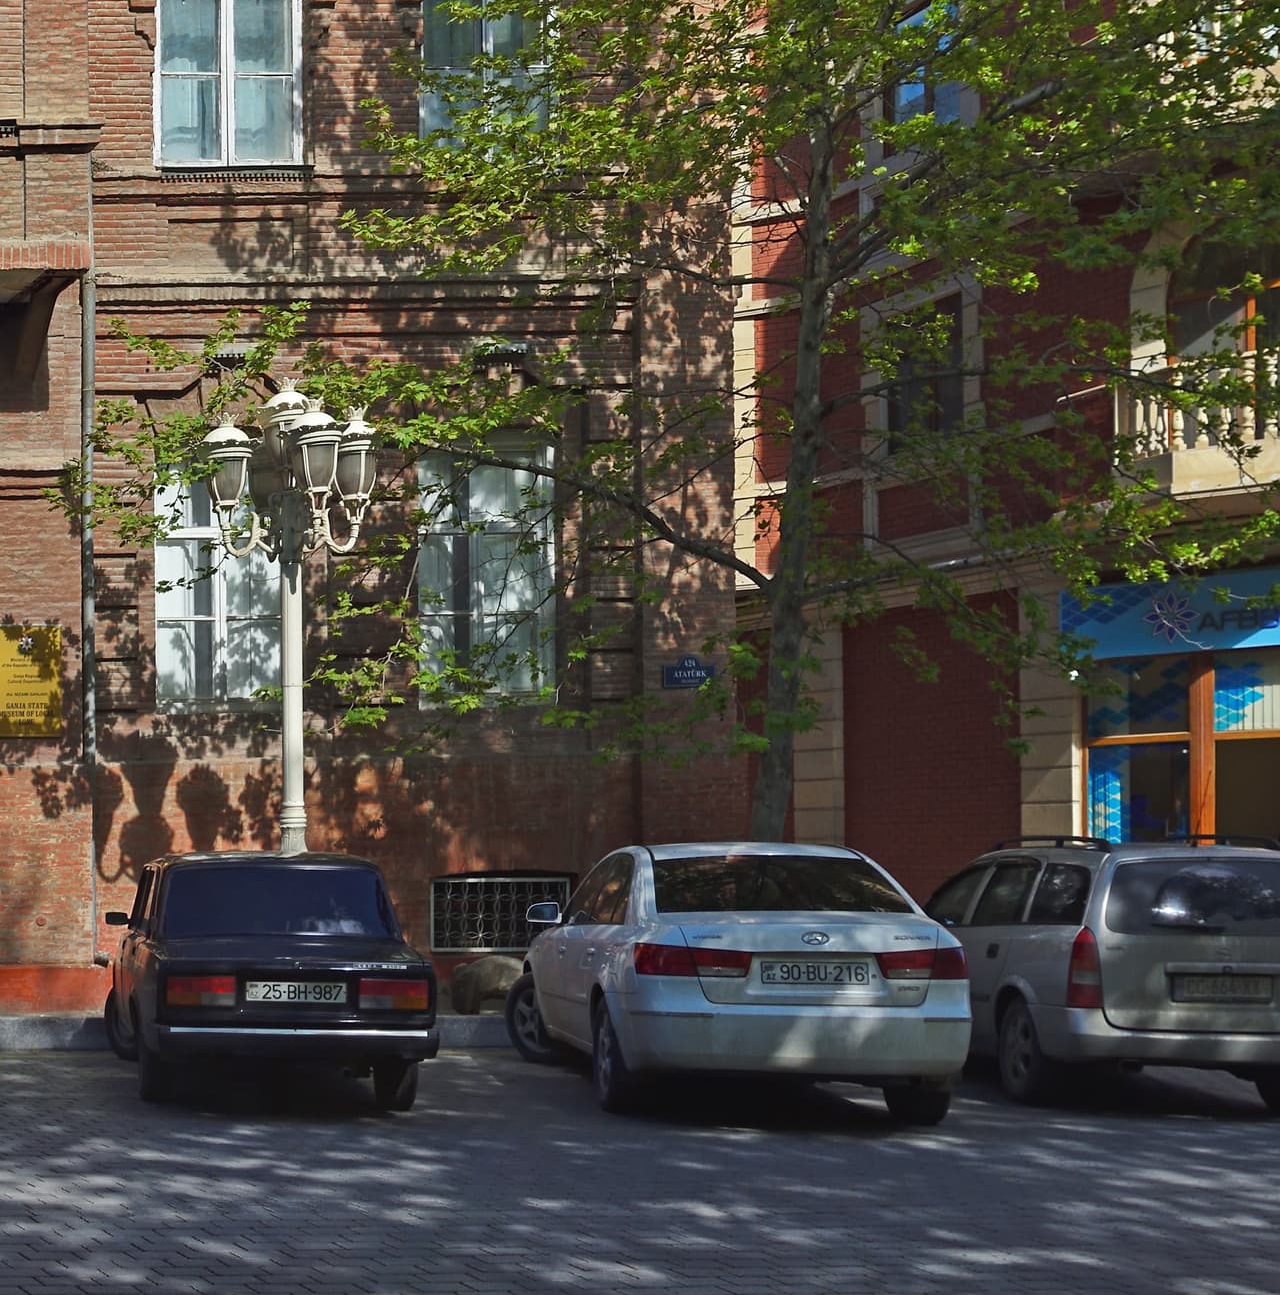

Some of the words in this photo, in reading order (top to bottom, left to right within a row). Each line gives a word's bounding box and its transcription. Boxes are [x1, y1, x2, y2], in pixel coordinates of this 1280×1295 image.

[673, 668, 707, 679] ATATÜRK
[779, 964, 866, 982] 90-BU-216
[262, 984, 343, 1001] 25-BH-987
